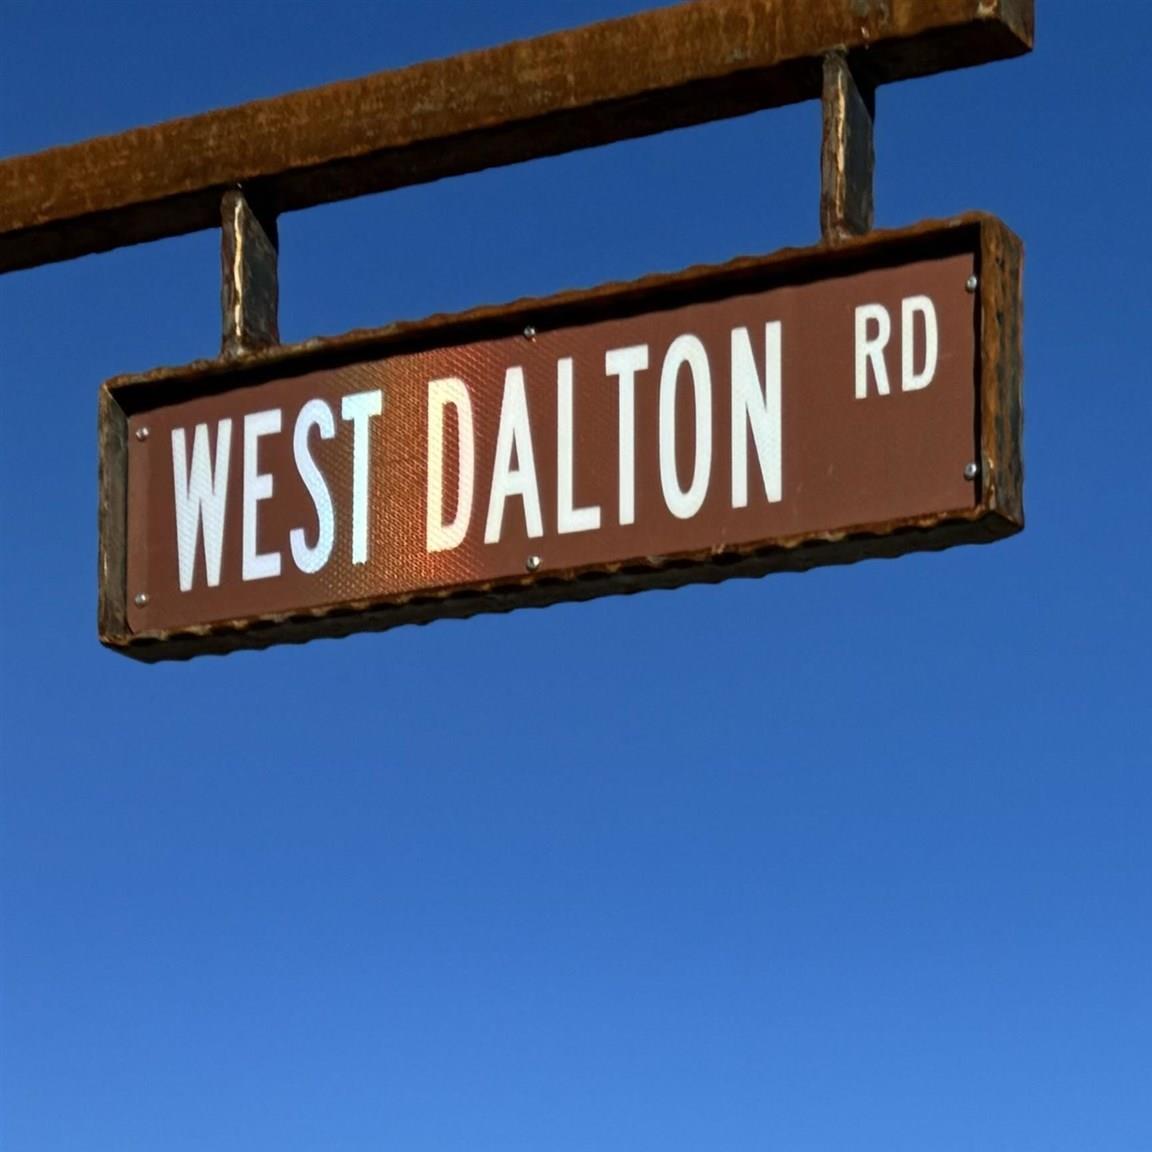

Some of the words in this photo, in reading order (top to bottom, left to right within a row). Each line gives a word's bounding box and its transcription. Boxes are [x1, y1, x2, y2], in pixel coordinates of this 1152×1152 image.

[171, 389, 383, 592] WEST
[426, 320, 782, 553] DALTON
[855, 295, 938, 399] RD
